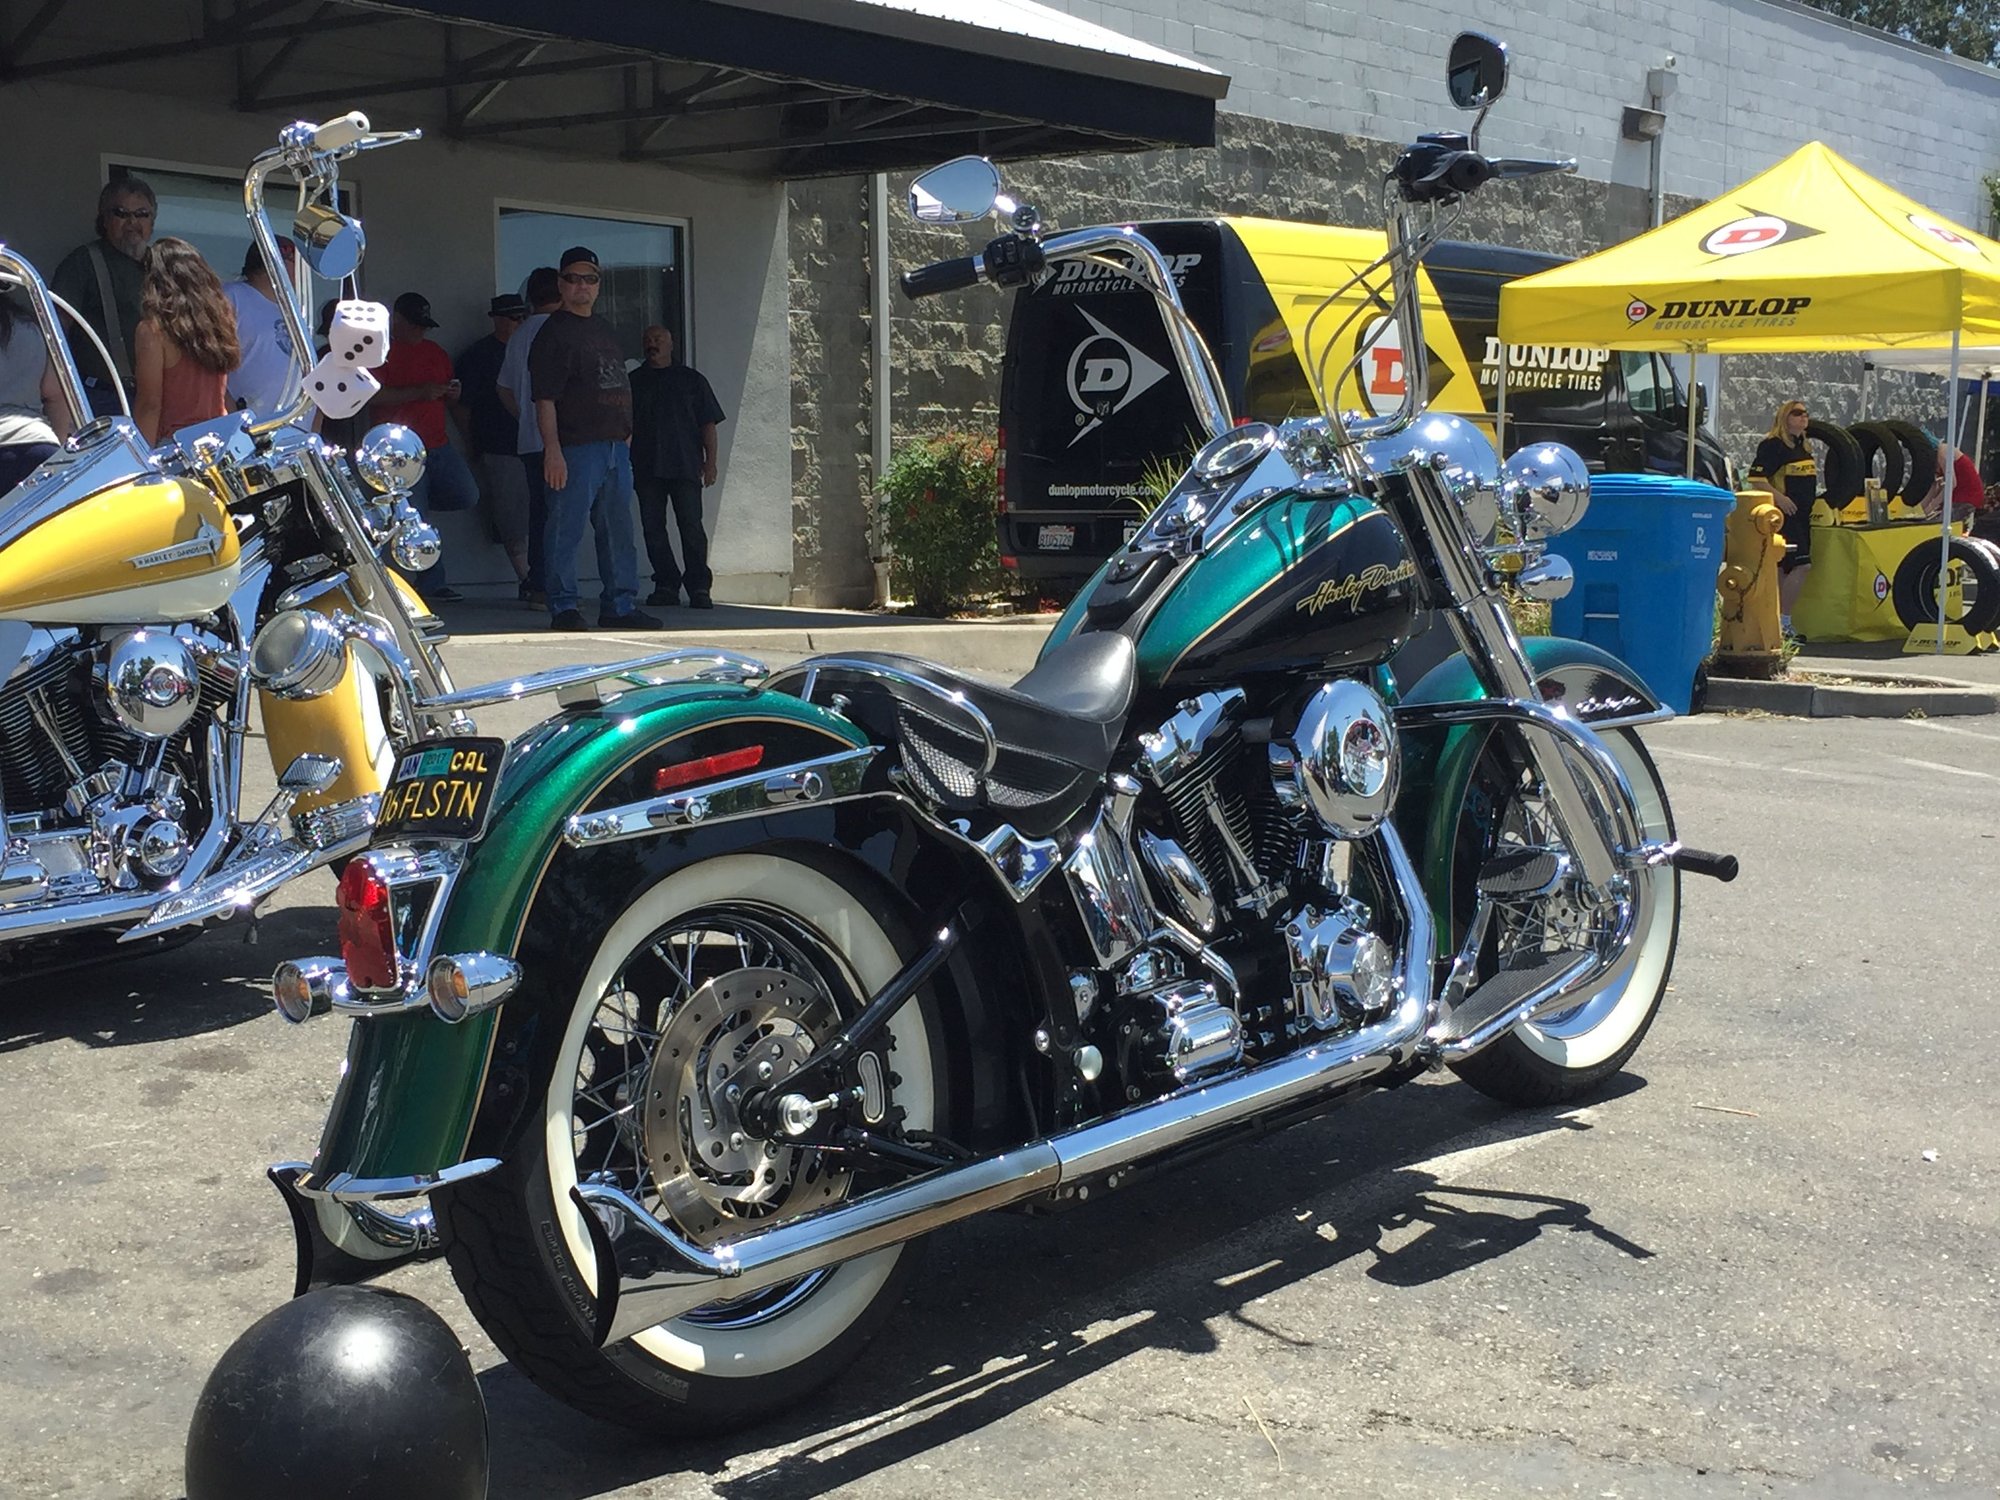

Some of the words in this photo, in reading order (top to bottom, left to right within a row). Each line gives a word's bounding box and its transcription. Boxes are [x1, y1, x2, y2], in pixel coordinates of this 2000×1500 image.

[1057, 253, 1202, 282] DUNLP
[1051, 278, 1136, 296] MOTORCYCLE
[1658, 297, 1812, 320] DUNLOP
[1653, 319, 1745, 331] MOTORCYCLE
[1753, 316, 1797, 328] TIRES
[1079, 357, 1130, 392] D
[1480, 368, 1562, 389] MOORCYCLE
[1567, 373, 1602, 392] TIRES
[401, 754, 422, 777] JAN
[450, 751, 488, 773] CAL
